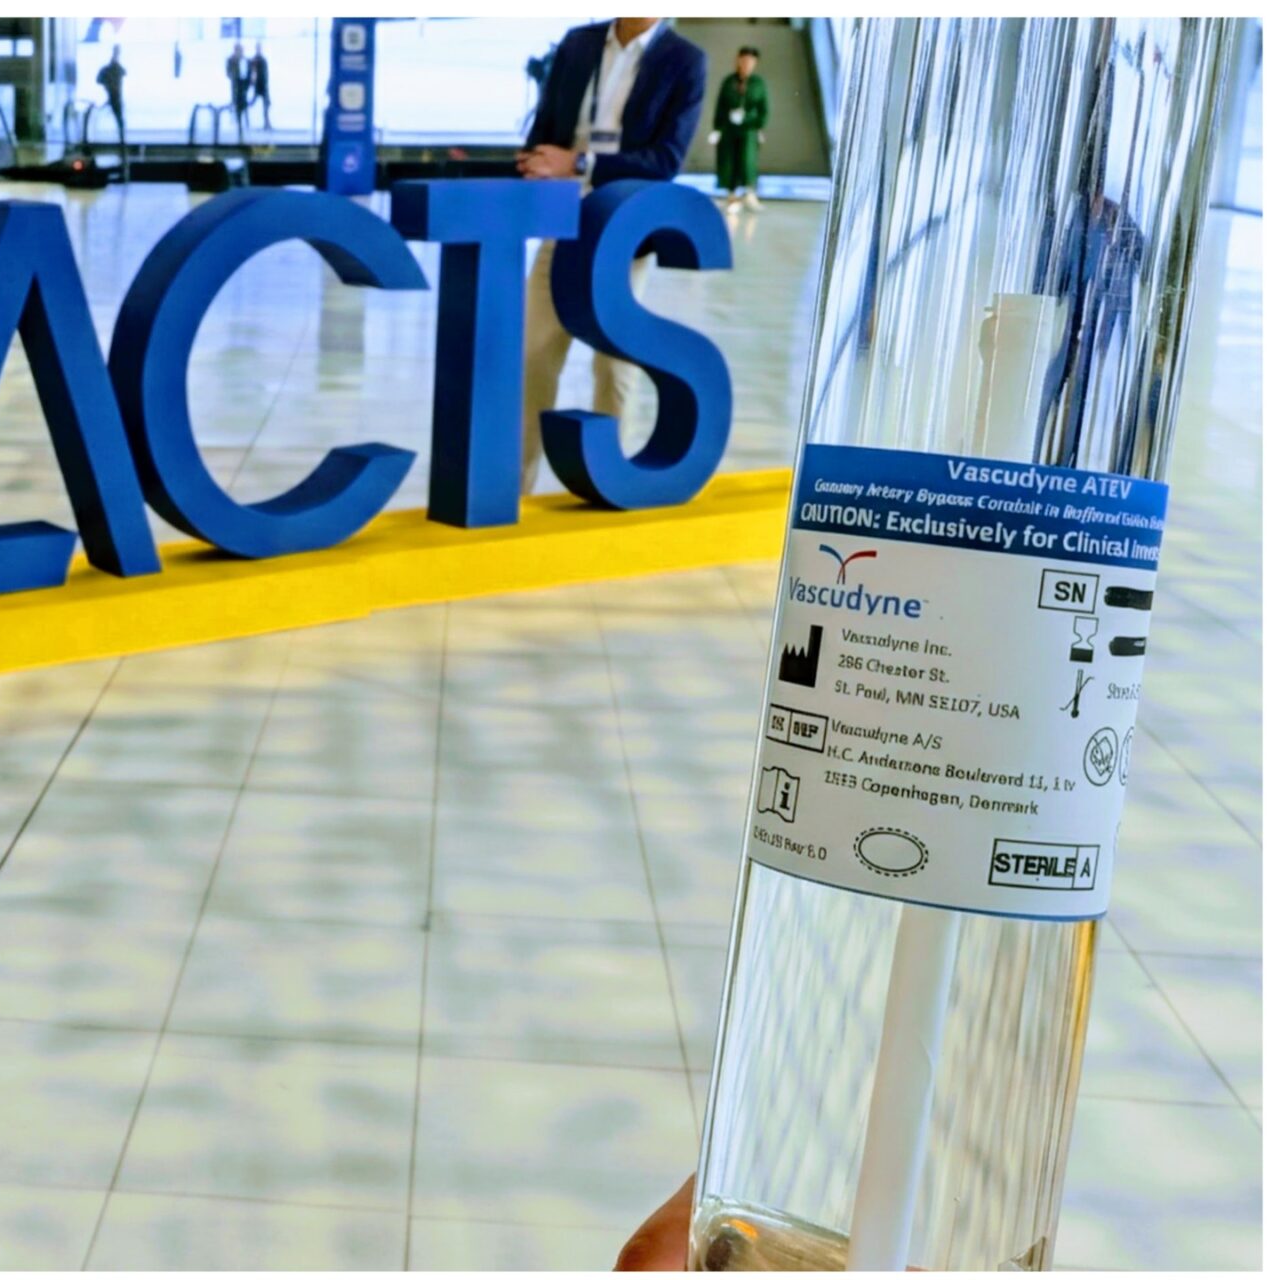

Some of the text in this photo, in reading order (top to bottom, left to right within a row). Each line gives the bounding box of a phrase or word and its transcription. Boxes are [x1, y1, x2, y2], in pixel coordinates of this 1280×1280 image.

[947, 460, 1132, 500] Vascudyne ATEV
[885, 511, 1017, 550] Exclusively
[1023, 526, 1057, 550] for
[1062, 531, 1128, 557] Clinical
[787, 576, 923, 618] Vascudyne
[1054, 580, 1088, 604] SN
[924, 639, 952, 656] Inc.
[929, 667, 950, 684] St.
[896, 690, 925, 706] MN
[988, 702, 1021, 720] USA
[912, 731, 943, 751] A/S
[861, 776, 1039, 816] Copenhagen, Denmark
[994, 853, 1091, 878] STERILE A
